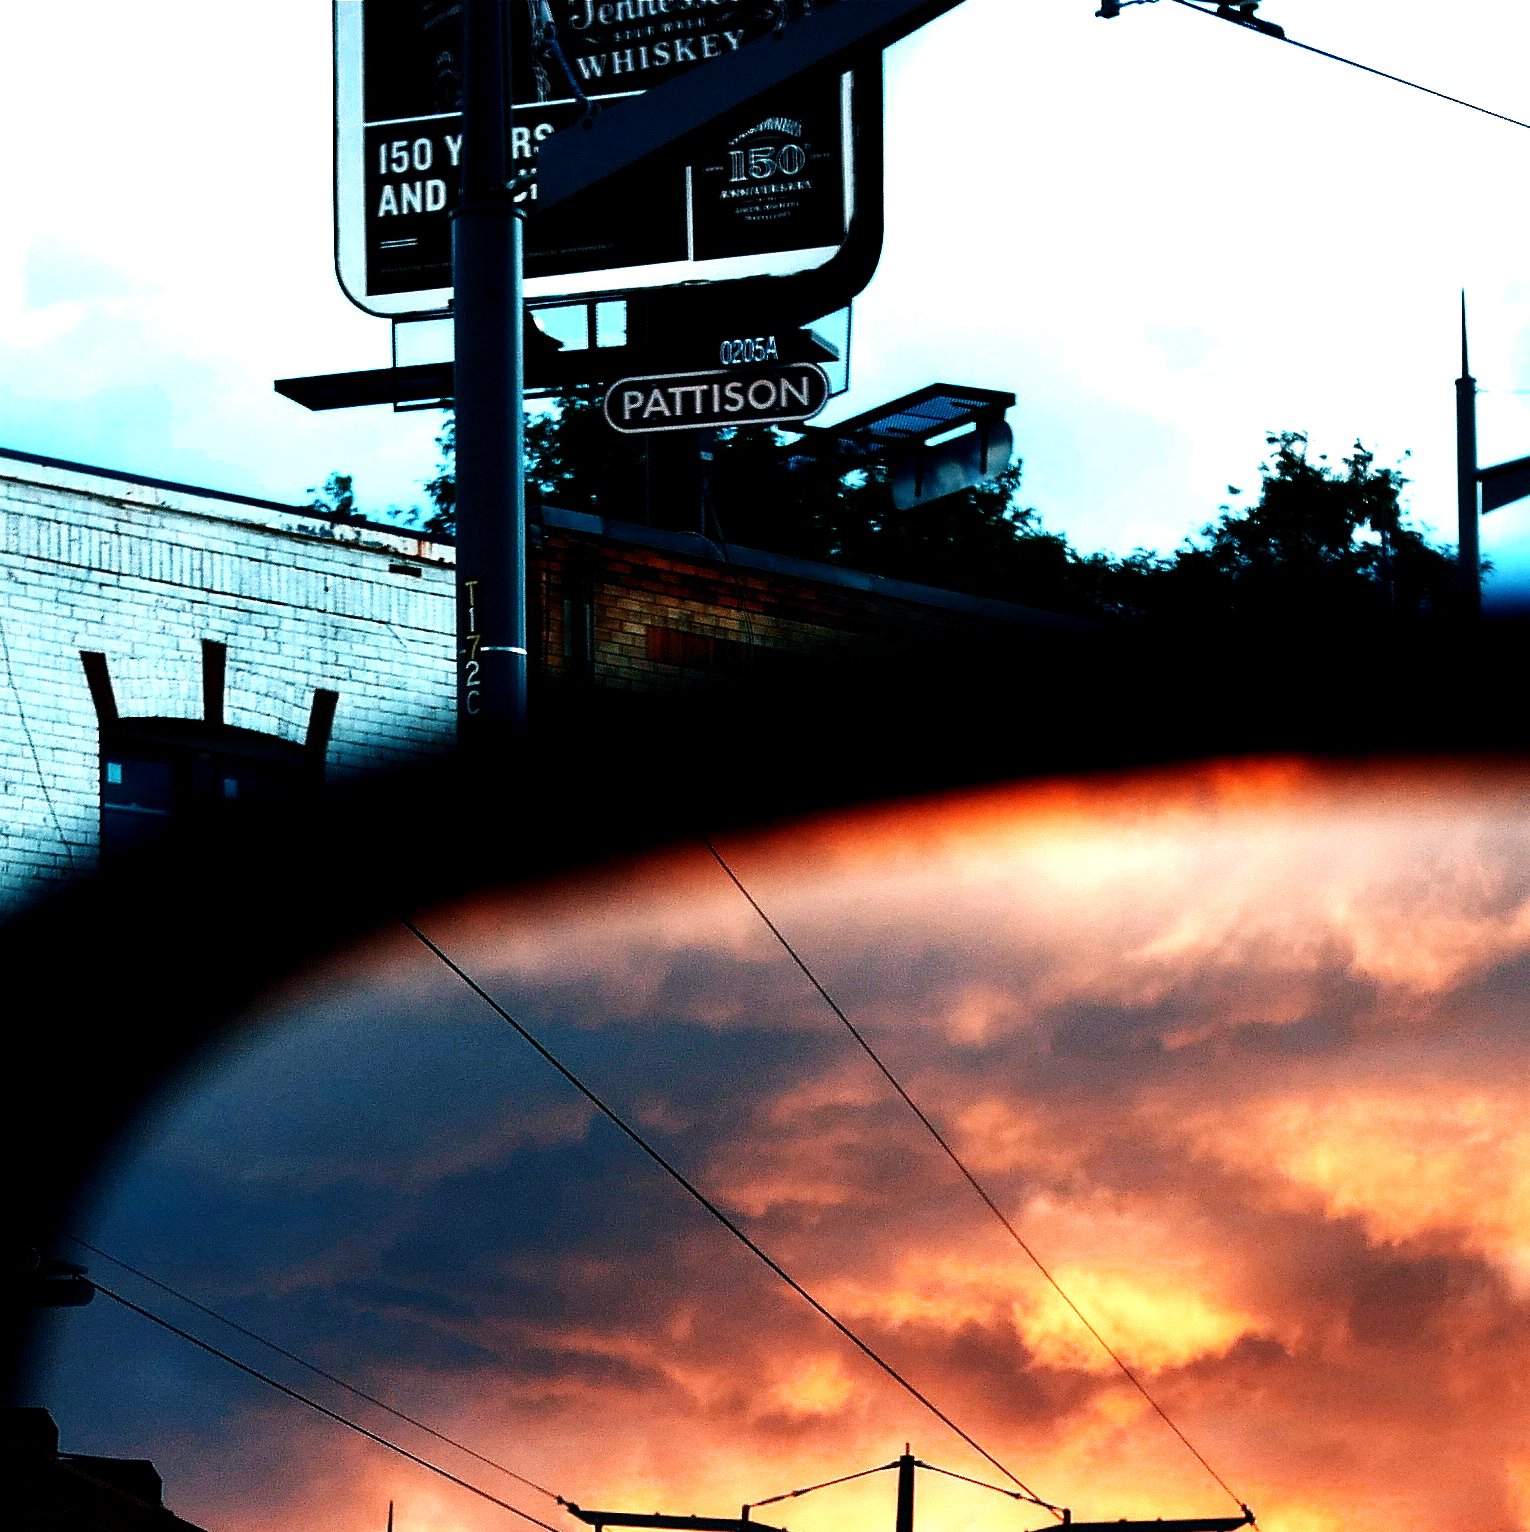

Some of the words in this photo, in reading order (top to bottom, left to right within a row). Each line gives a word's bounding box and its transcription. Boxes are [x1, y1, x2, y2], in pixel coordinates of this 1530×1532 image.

[575, 28, 745, 81] WHISKEY
[378, 137, 434, 175] 150
[443, 122, 555, 167] YRS
[727, 143, 806, 182] 150
[377, 178, 447, 218] AND
[719, 335, 779, 364] 0205A
[622, 376, 810, 420] PATTISON
